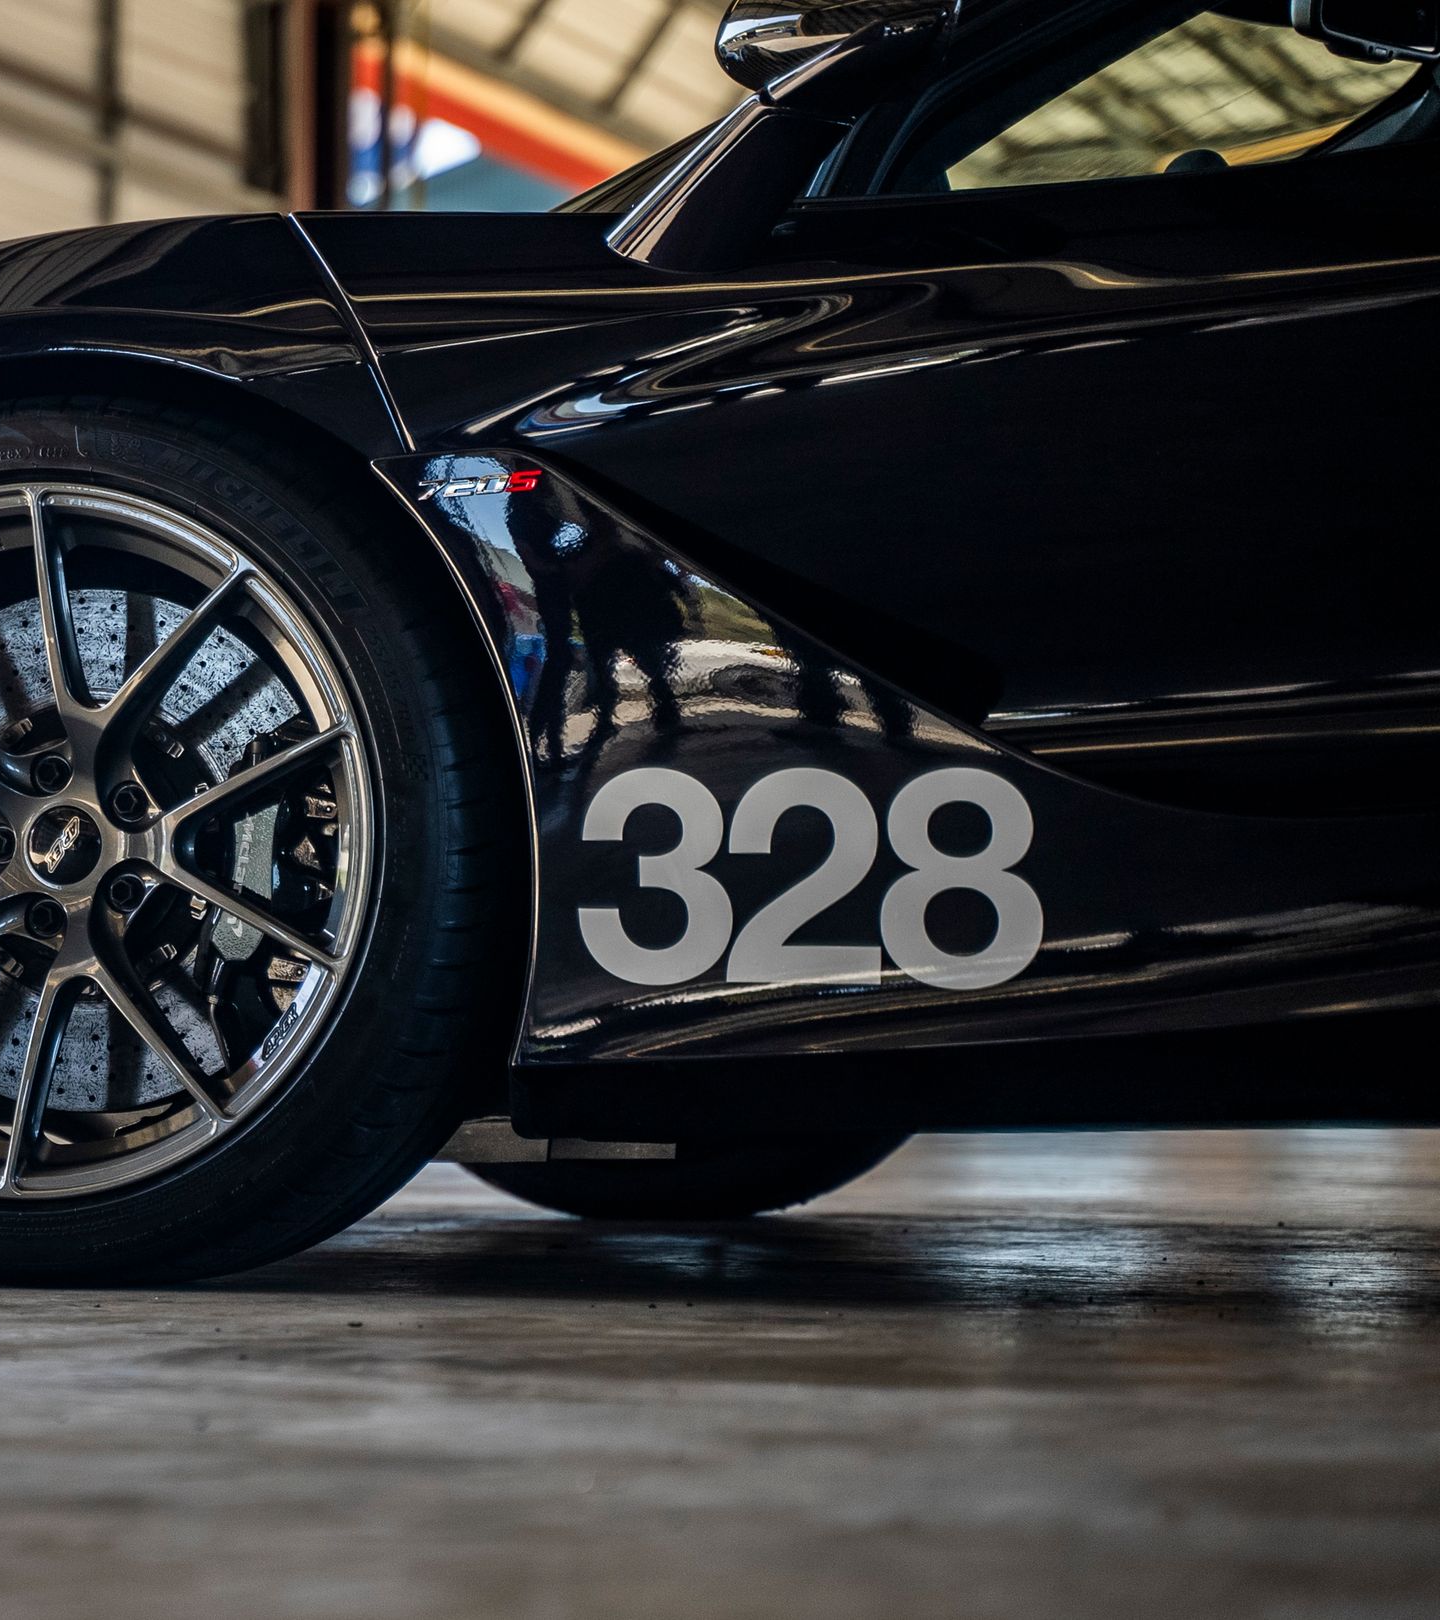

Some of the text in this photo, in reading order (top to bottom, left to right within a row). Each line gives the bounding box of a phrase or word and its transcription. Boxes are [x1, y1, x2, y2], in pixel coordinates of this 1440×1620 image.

[418, 469, 542, 501] 720S
[44, 816, 80, 873] APEX
[578, 767, 1044, 990] 328
[262, 1002, 298, 1061] APEX
